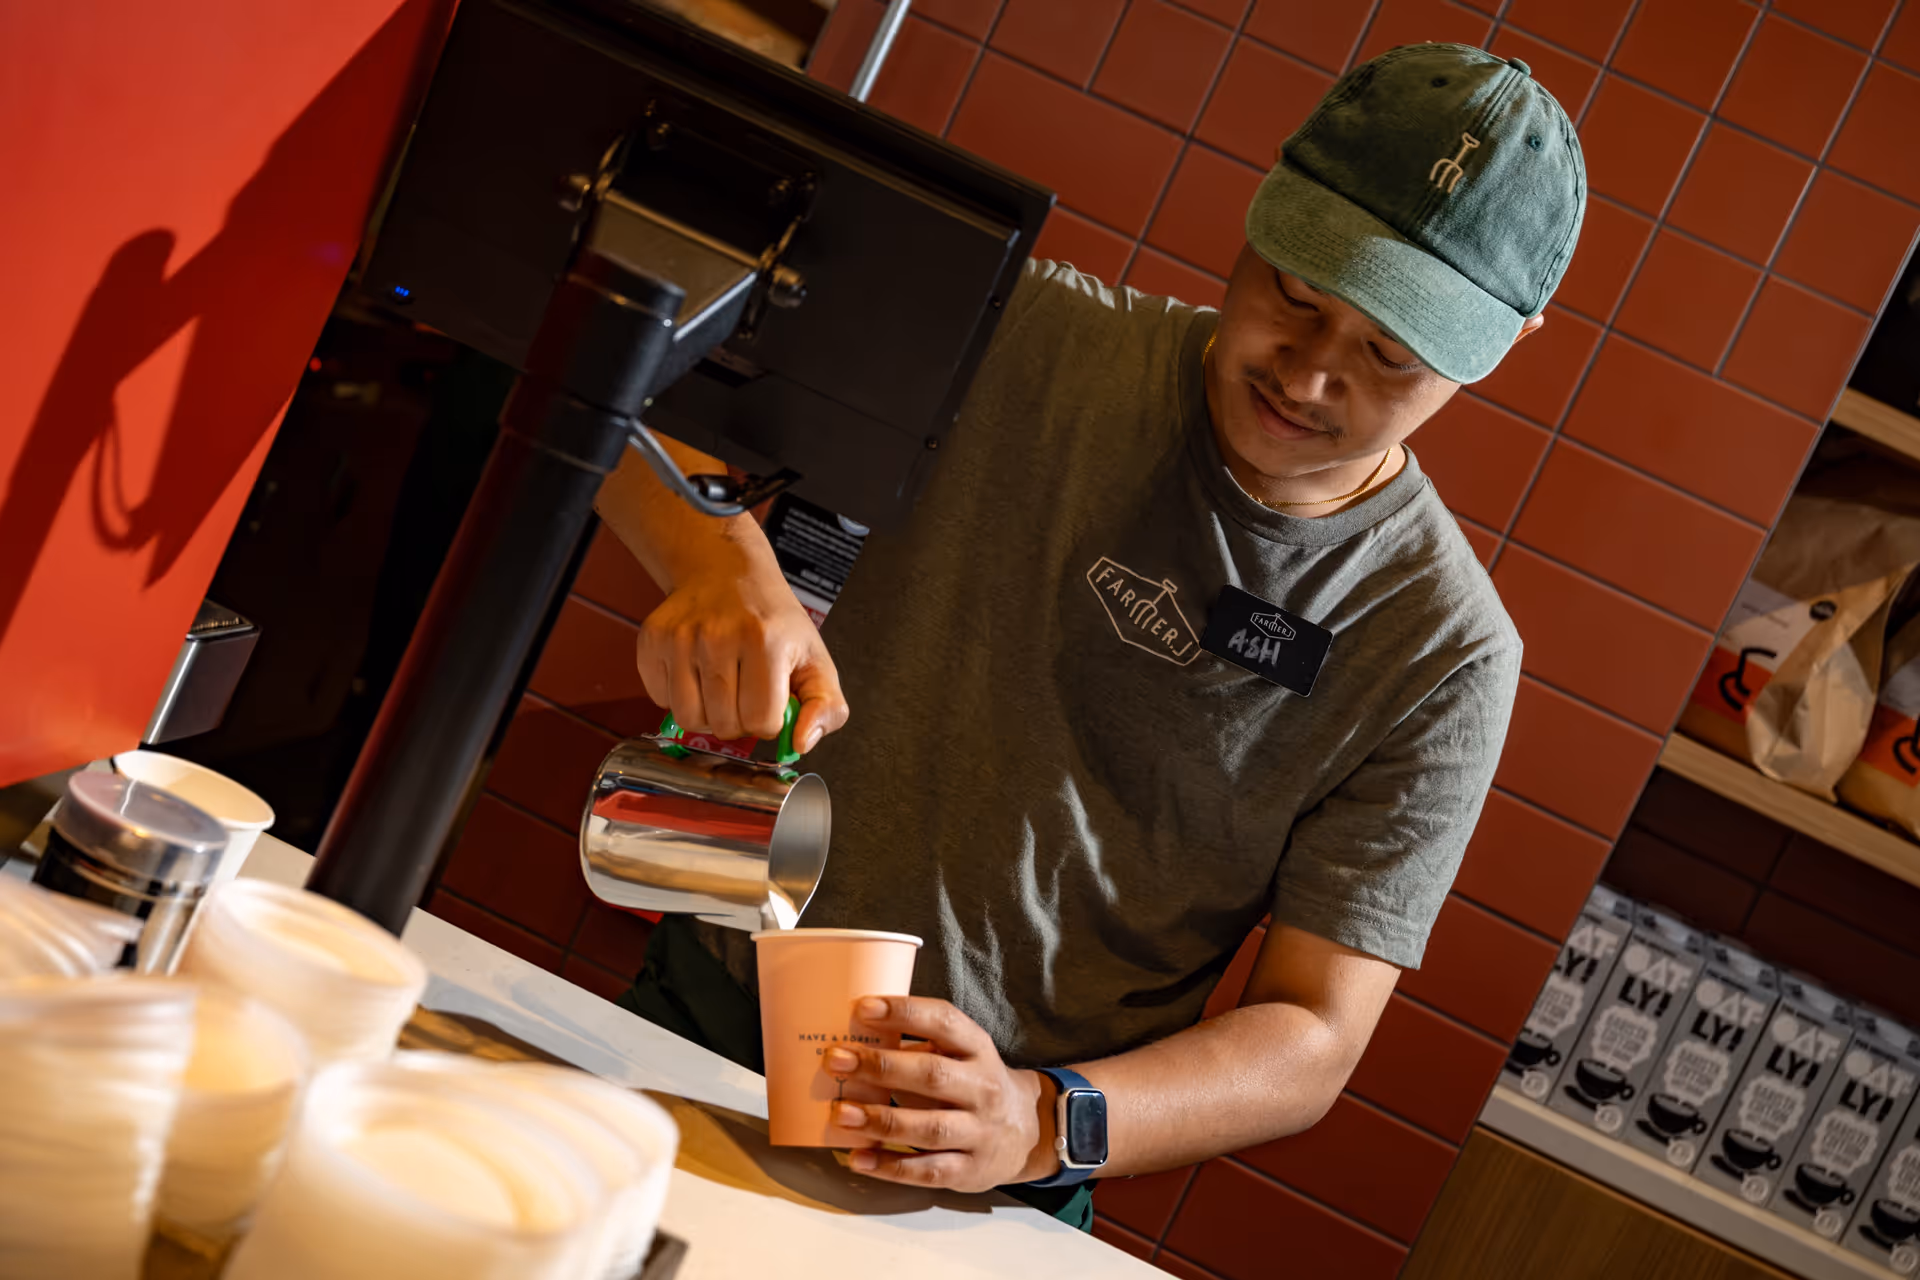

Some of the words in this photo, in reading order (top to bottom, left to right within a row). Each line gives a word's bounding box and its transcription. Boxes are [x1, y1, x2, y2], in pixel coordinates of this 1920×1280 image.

[1096, 566, 1178, 646] FARMER
[1254, 614, 1287, 636] FARMER
[1227, 628, 1281, 666] ASH
[1618, 975, 1672, 1017] LY!
[799, 1033, 826, 1042] HAVE
[1691, 1010, 1744, 1052] LY!
[1766, 1045, 1820, 1088] LY!
[1839, 1080, 1894, 1123] LY!
